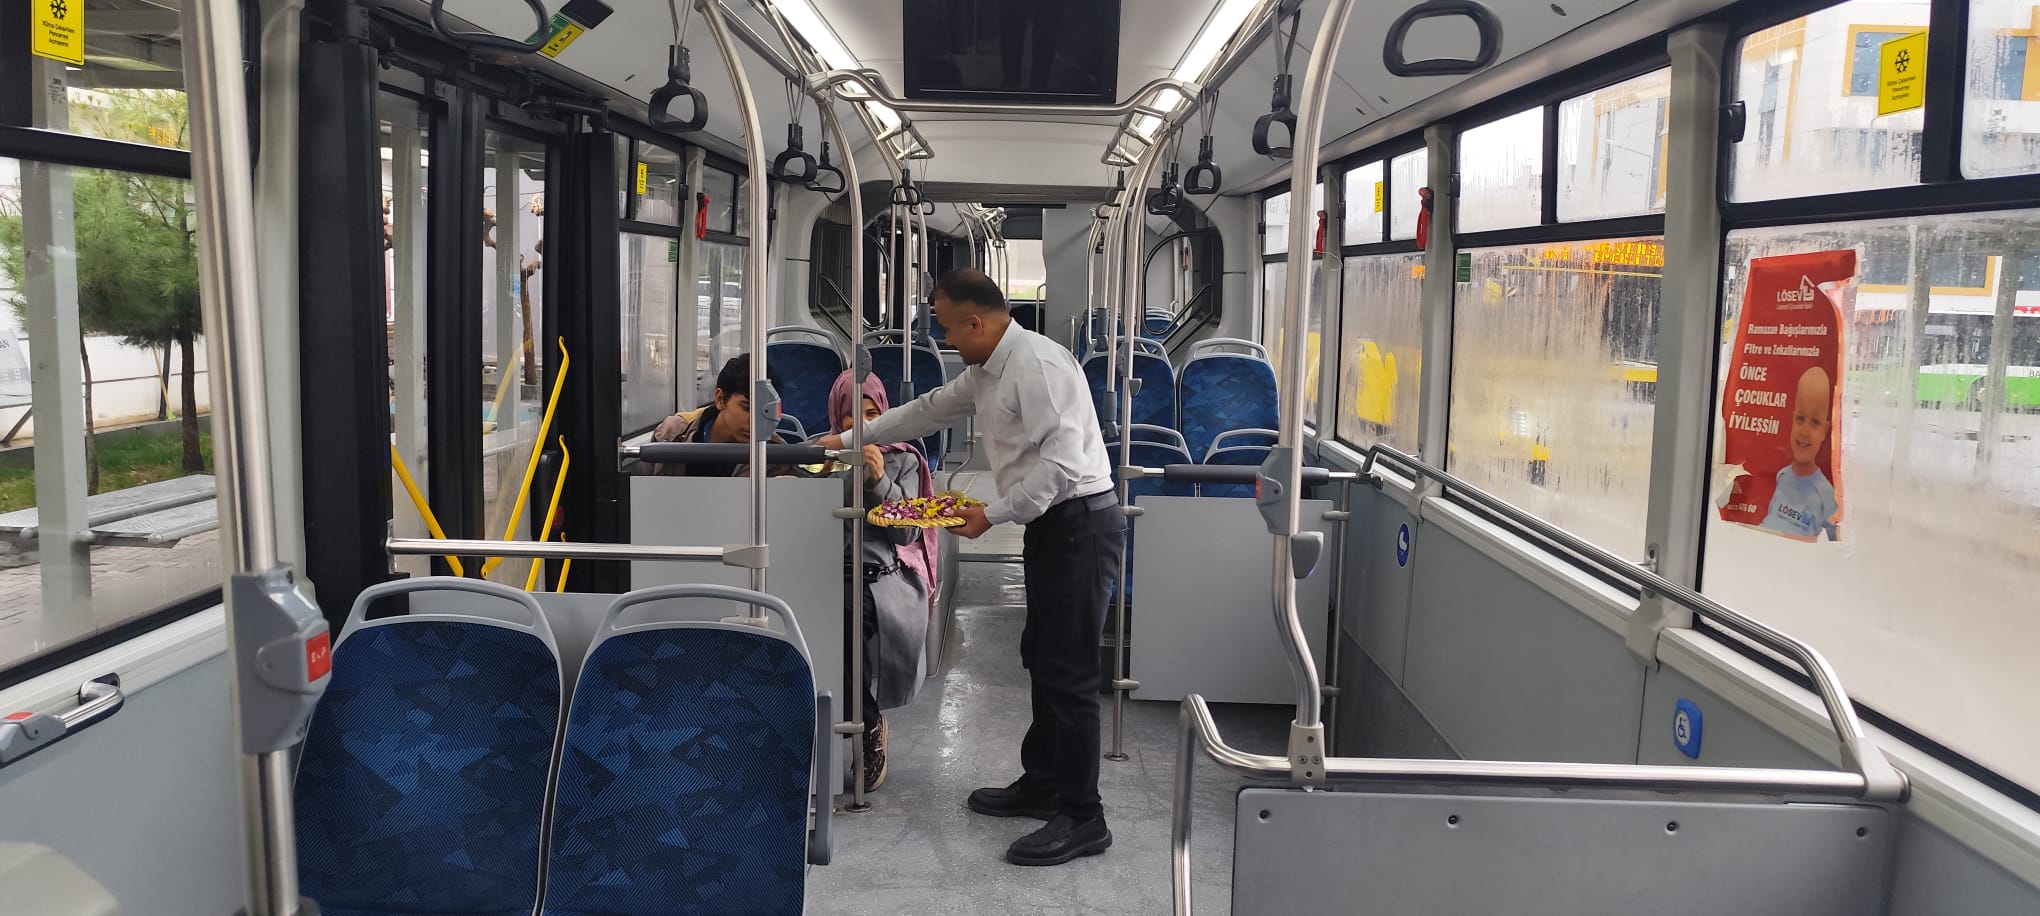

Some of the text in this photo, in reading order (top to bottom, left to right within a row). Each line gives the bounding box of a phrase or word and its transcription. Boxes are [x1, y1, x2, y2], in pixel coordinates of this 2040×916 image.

[1777, 289, 1802, 302] LÖSEV
[1748, 323, 1778, 335] Ramazan
[1744, 343, 1763, 354] Fitre
[1764, 346, 1772, 355] ve
[1740, 362, 1768, 381] ÖNCE
[1735, 388, 1788, 408] ÇOCUKLAR
[1728, 411, 1780, 436] İYİLEŞSİN
